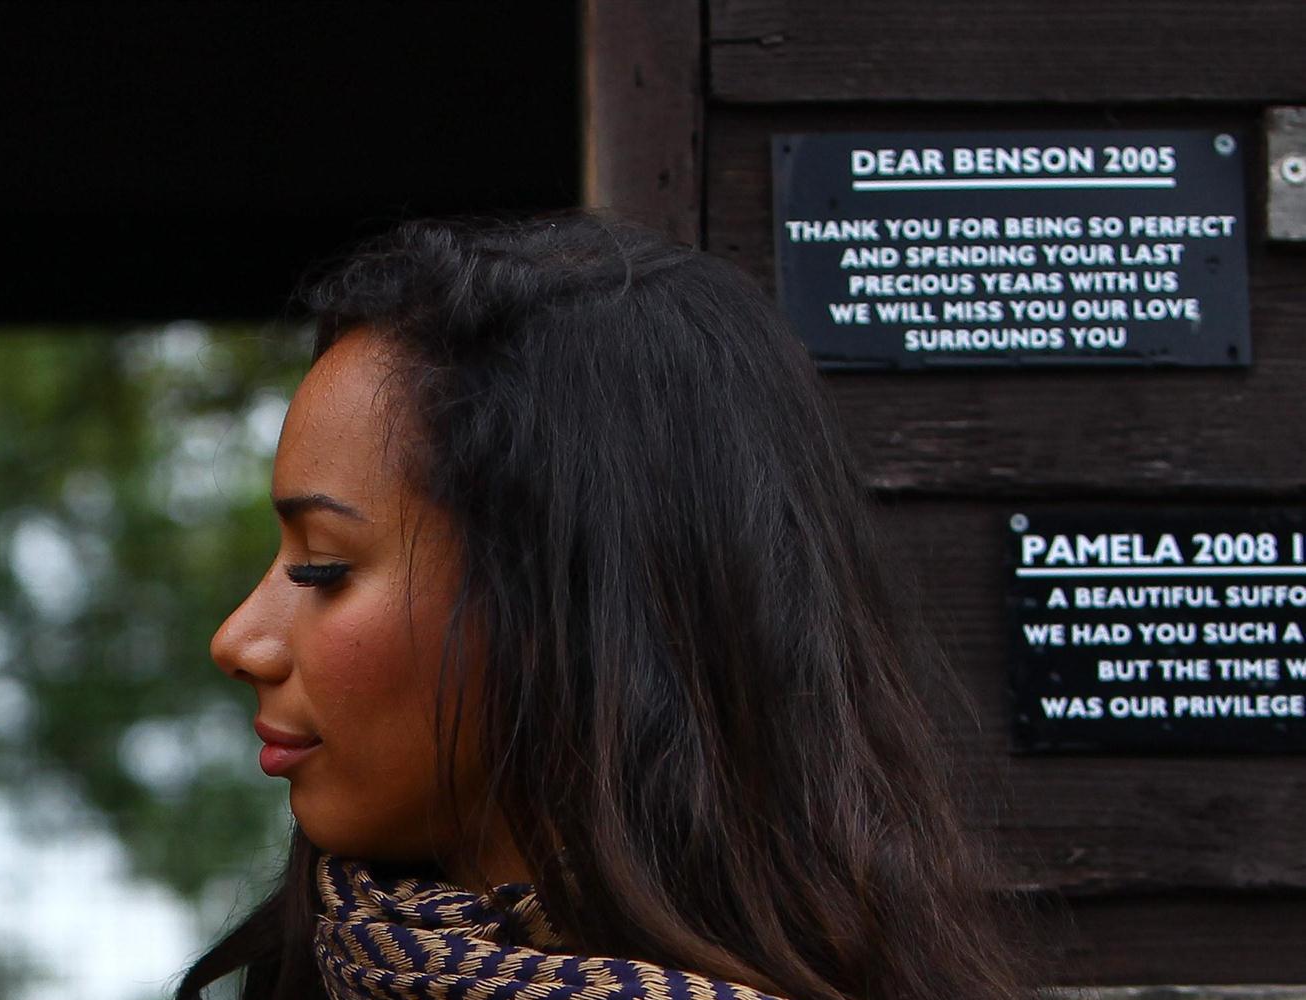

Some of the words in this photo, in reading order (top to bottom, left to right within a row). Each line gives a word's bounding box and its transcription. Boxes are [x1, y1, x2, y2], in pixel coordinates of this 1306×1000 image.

[850, 148, 945, 177] DEAR
[953, 147, 1096, 176] BENSON
[1104, 145, 1177, 173] 2005
[786, 219, 880, 242] THANK
[885, 218, 941, 240] YOU
[947, 218, 999, 240] FOR
[1005, 217, 1083, 239] BEING
[1087, 217, 1124, 238] SO
[1129, 216, 1236, 238] PERFECT
[840, 246, 899, 269] AND
[905, 245, 1037, 267] SPENDING
[1042, 244, 1116, 266] YOUR
[1120, 243, 1184, 266] LAST
[849, 273, 976, 296] PRECIOUS
[980, 272, 1063, 294] YEARS
[1068, 271, 1138, 293] WITH
[1143, 271, 1179, 292] US
[829, 303, 870, 325] WE
[874, 302, 938, 324] WILL
[943, 301, 1004, 323] MISS
[1009, 300, 1066, 322] YOU
[1071, 300, 1128, 322] OUR
[1133, 299, 1200, 321] LOVE
[904, 328, 1065, 351] SURROUNDS
[1069, 327, 1127, 349] YOU
[1020, 533, 1184, 566] PAMELA
[1191, 532, 1278, 563] 2008
[1046, 587, 1068, 609] A
[1073, 585, 1220, 609] BEAUTIFUL
[1225, 585, 1306, 607] SUFFO
[1023, 623, 1066, 646] WE
[1071, 623, 1132, 645] HAD
[1138, 622, 1197, 644] YOU
[1203, 622, 1277, 643] SUCH
[1282, 621, 1303, 642] A
[1097, 659, 1153, 682] BUT
[1157, 659, 1211, 681] THE
[1215, 658, 1280, 681] TIME
[1041, 696, 1103, 719] WAS
[1109, 696, 1168, 718] OUR
[1173, 694, 1305, 717] PRIVILEGE
